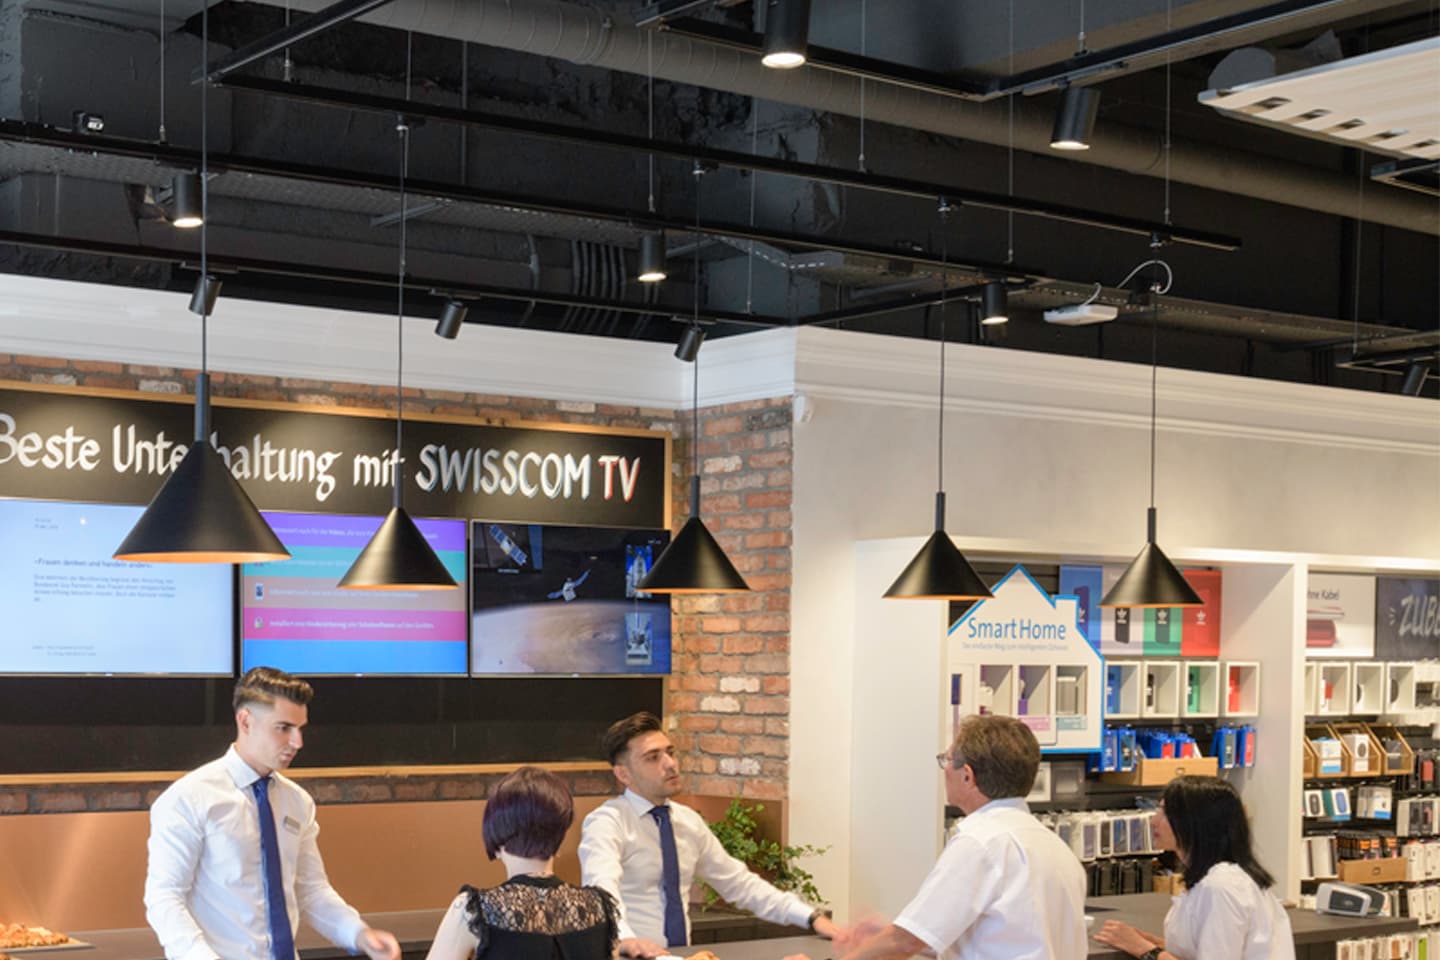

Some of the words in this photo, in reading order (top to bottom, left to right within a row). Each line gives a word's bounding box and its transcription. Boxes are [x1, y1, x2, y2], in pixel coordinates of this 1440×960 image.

[112, 423, 343, 502] Untehaltung
[353, 448, 406, 488] mit
[415, 443, 591, 500] SWISSCOM
[598, 454, 641, 503] TV
